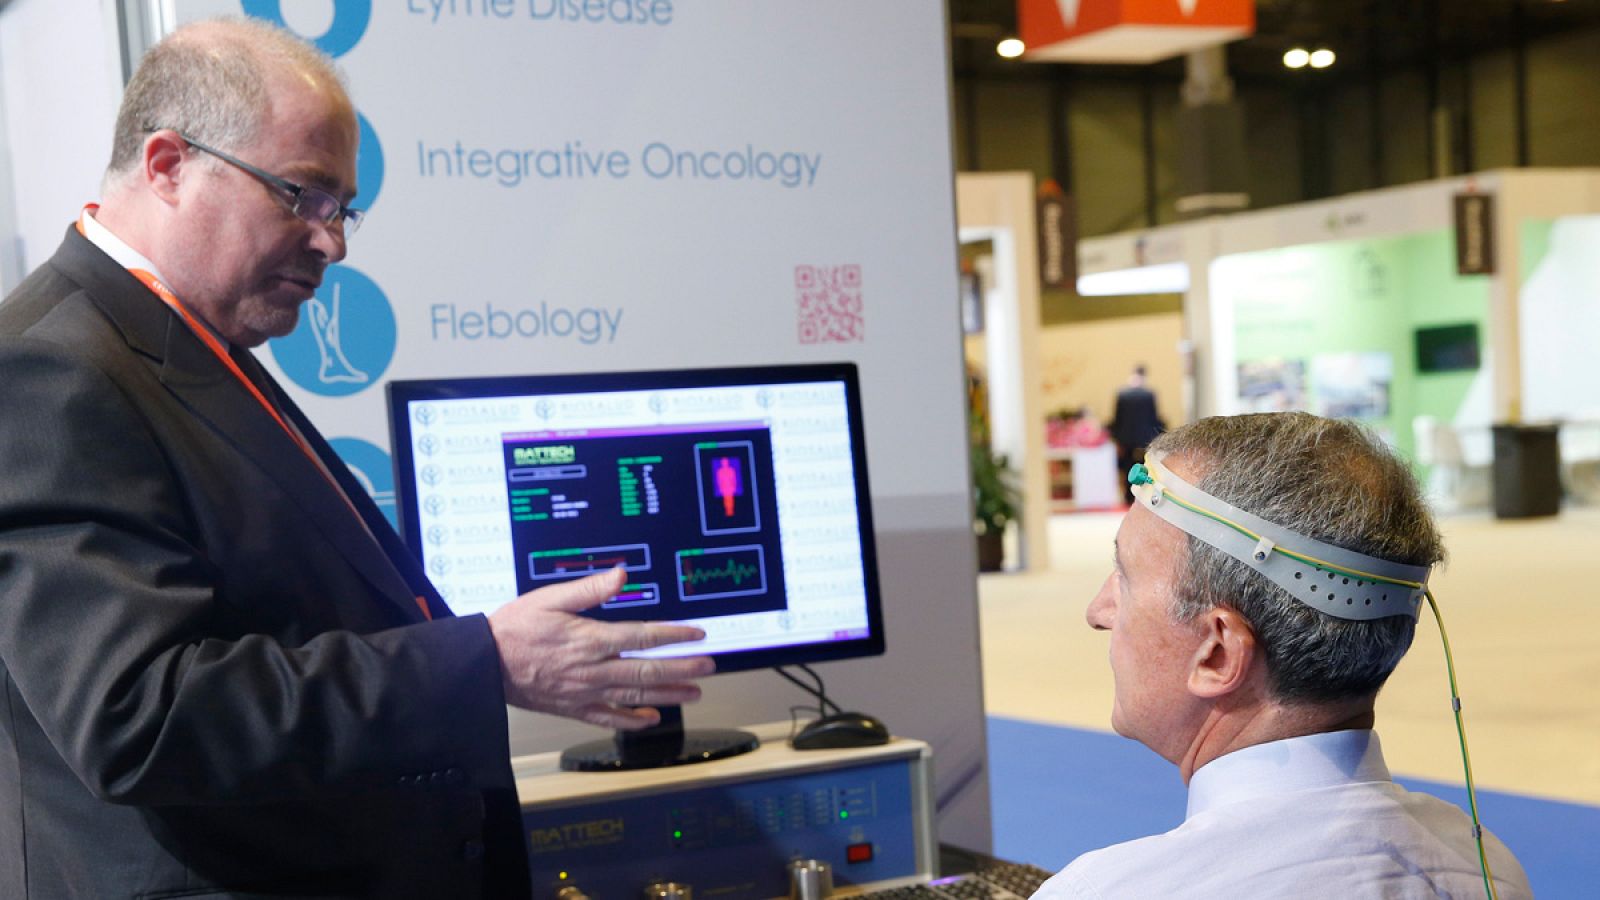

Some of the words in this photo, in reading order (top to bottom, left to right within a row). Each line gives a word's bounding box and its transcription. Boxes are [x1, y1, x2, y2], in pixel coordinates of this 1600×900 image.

[417, 140, 630, 187] Integrative
[641, 142, 821, 188] Oncology
[429, 302, 624, 344] Flebology
